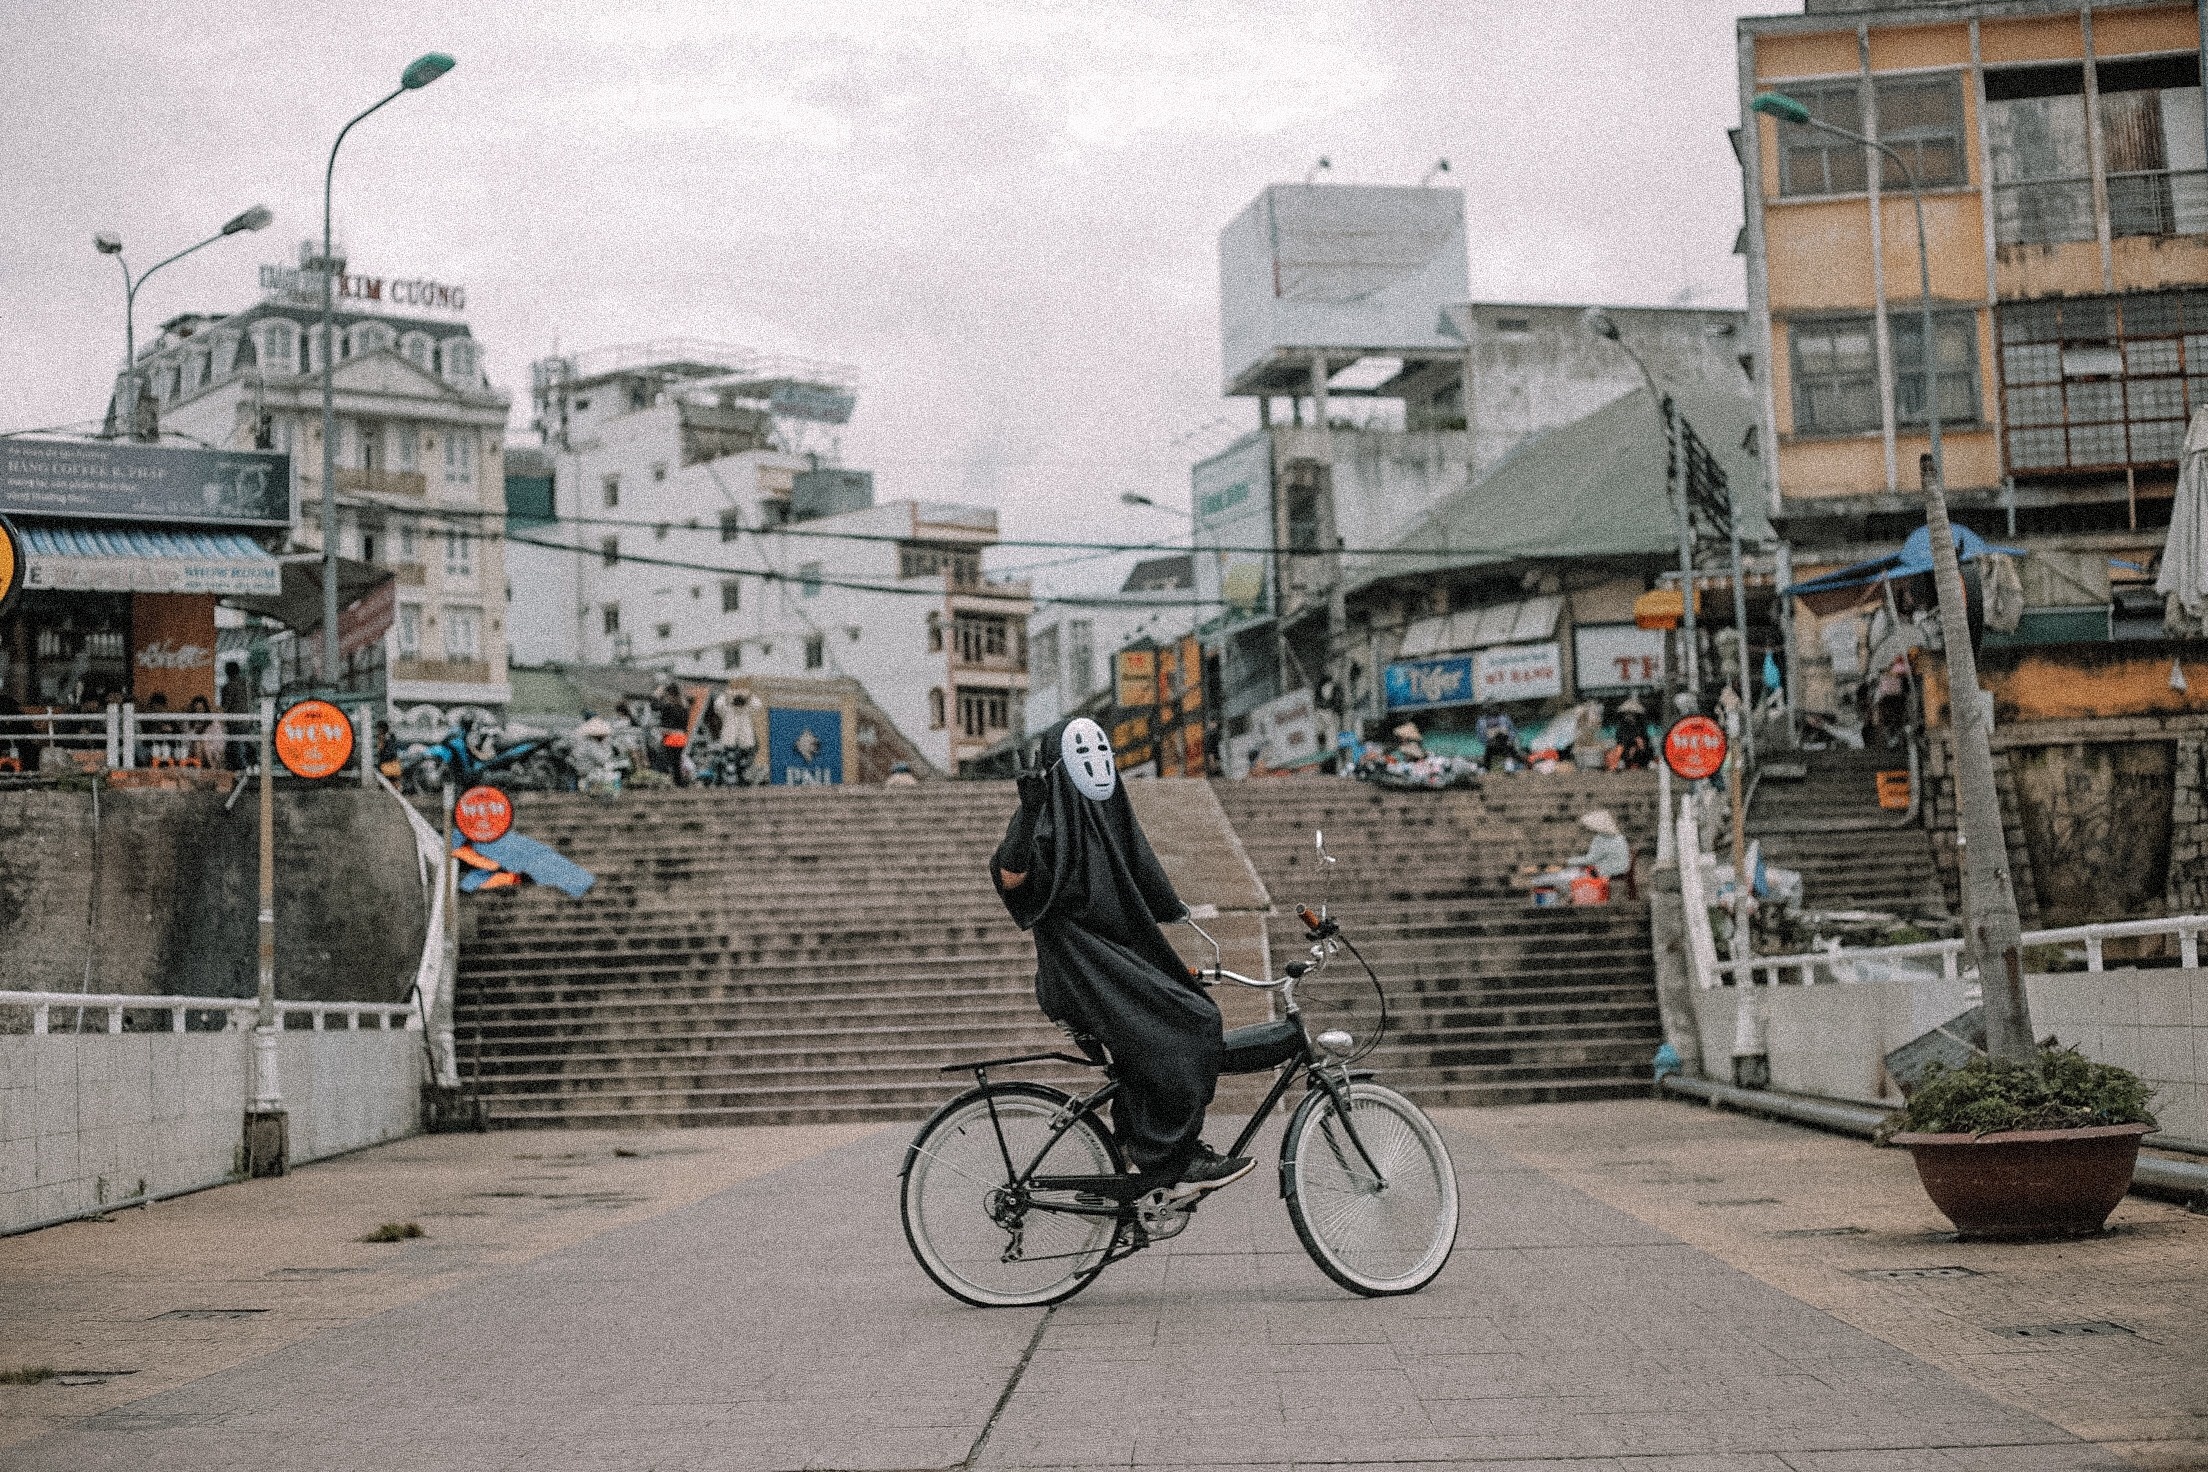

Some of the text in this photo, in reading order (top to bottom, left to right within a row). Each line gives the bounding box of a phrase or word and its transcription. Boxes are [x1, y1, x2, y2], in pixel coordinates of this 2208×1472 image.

[339, 275, 383, 301] KIM
[391, 277, 467, 310] CƯƠNG
[1408, 664, 1464, 702] Tiger
